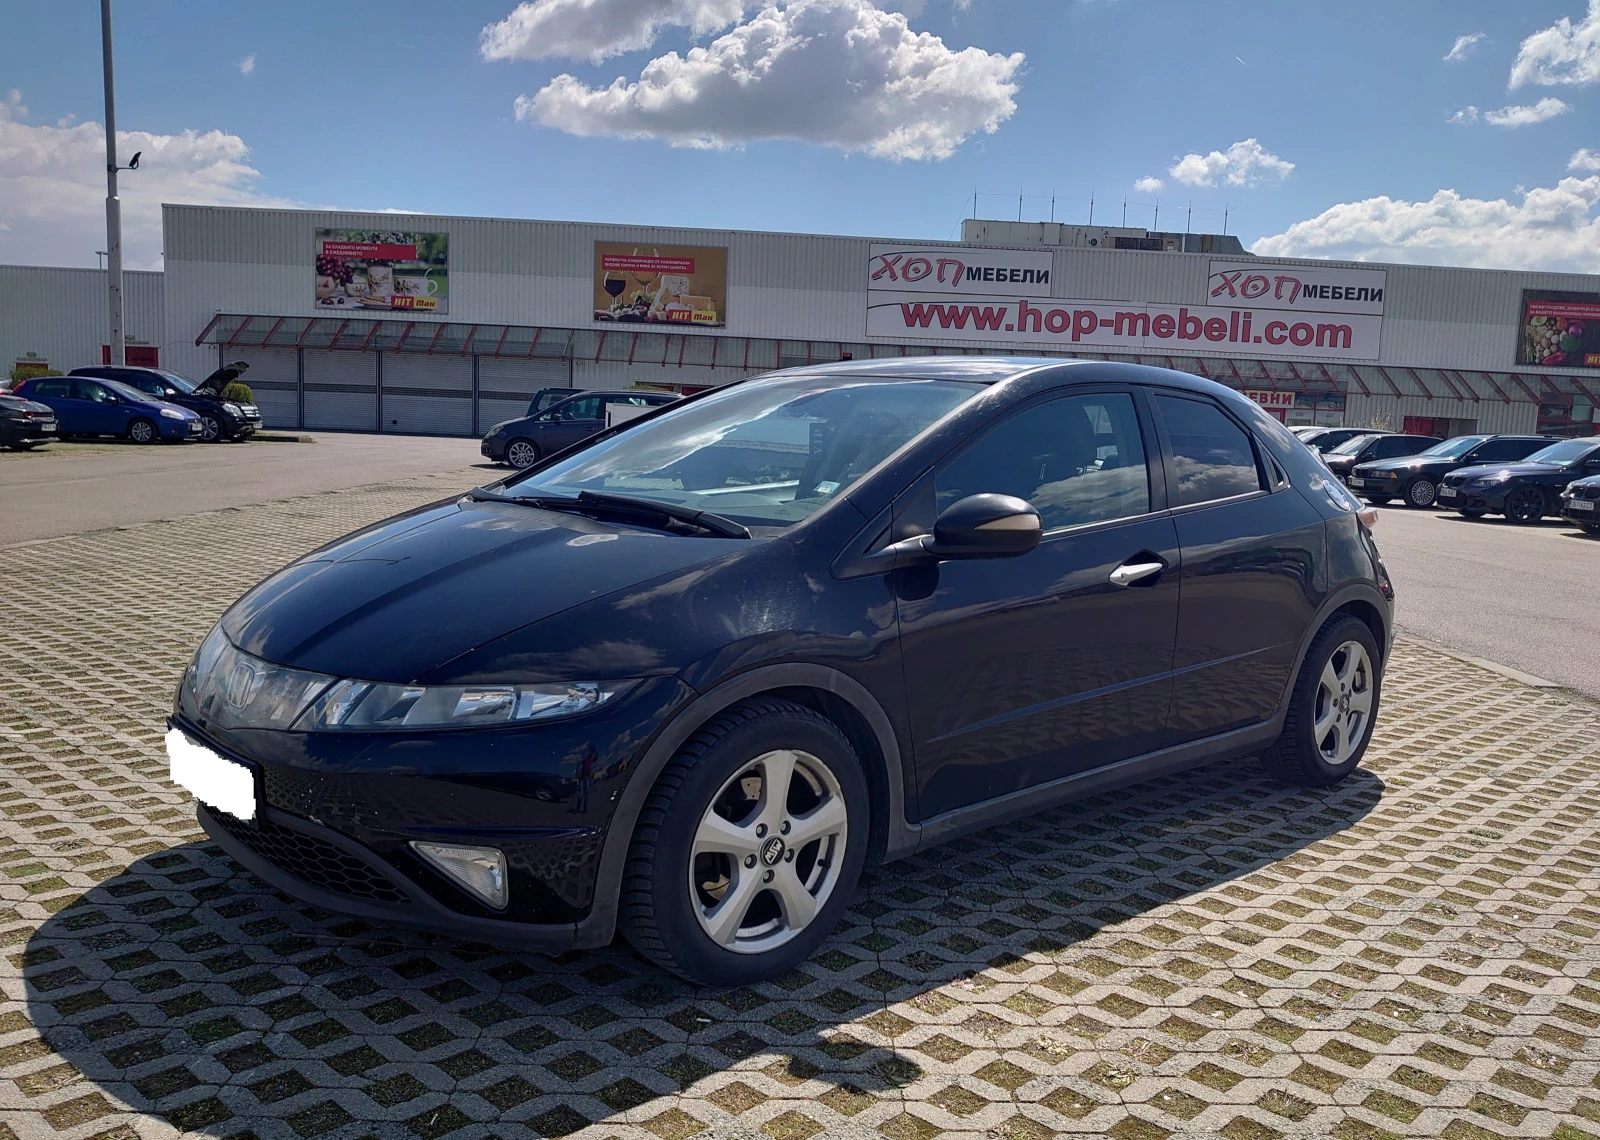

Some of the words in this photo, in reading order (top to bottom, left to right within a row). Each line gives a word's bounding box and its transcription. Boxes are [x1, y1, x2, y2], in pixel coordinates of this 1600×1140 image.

[871, 254, 966, 287] ХОП
[966, 266, 1050, 284] МЕБЕЛИ
[1210, 271, 1302, 304] ХОП
[1302, 284, 1383, 302] МЕБЕЛИ
[394, 297, 412, 306] HIT
[672, 311, 689, 320] HIT
[901, 300, 1353, 349] www.hop-mebeli.com
[1243, 391, 1292, 405] ЕВНИ
